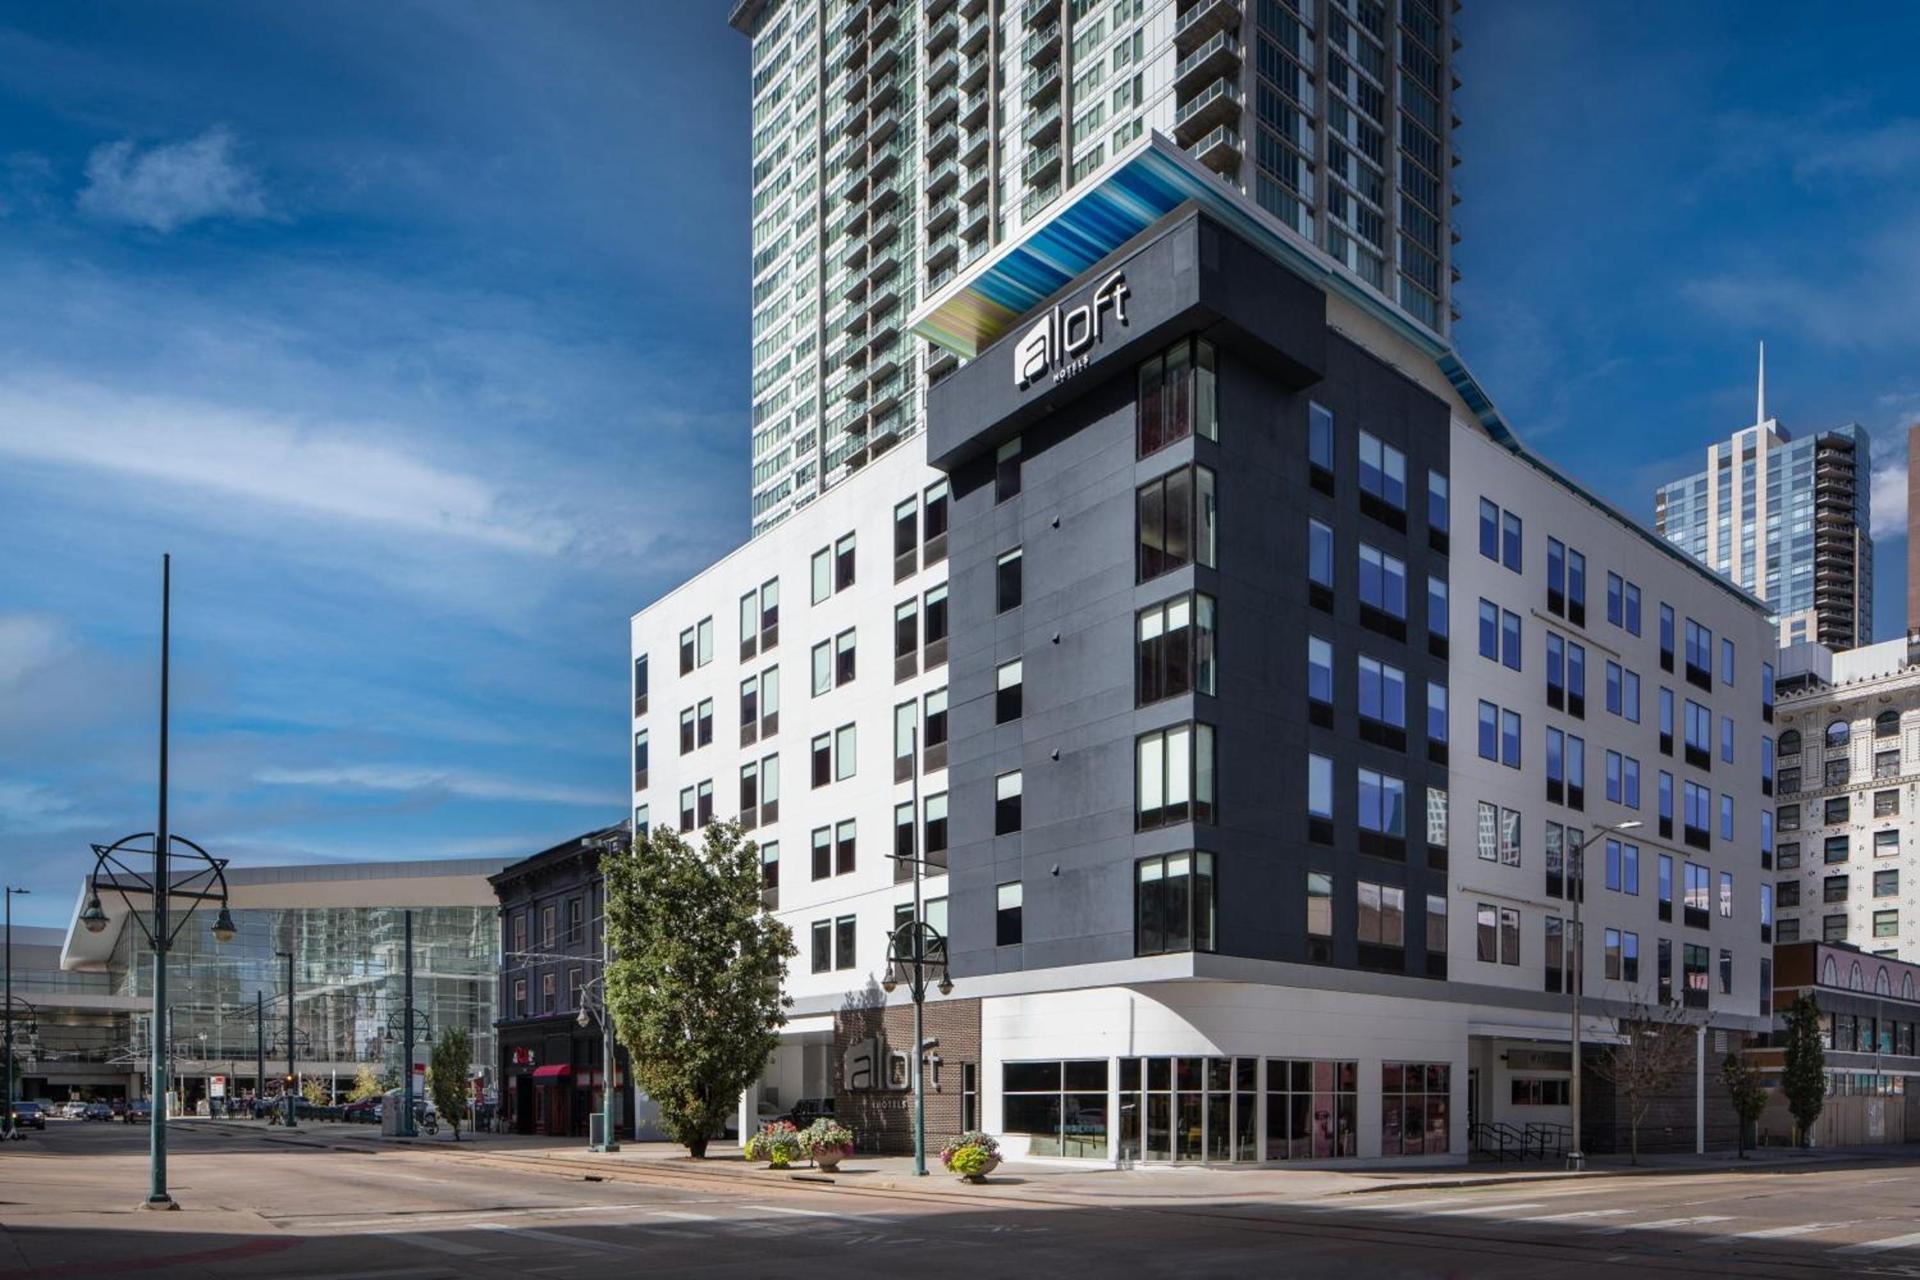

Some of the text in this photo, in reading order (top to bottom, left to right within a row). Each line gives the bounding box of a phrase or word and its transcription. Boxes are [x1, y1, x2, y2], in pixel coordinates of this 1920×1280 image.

[1014, 269, 1127, 385] aloft
[1053, 354, 1089, 383] HOTELS
[844, 1033, 941, 1090] aloft
